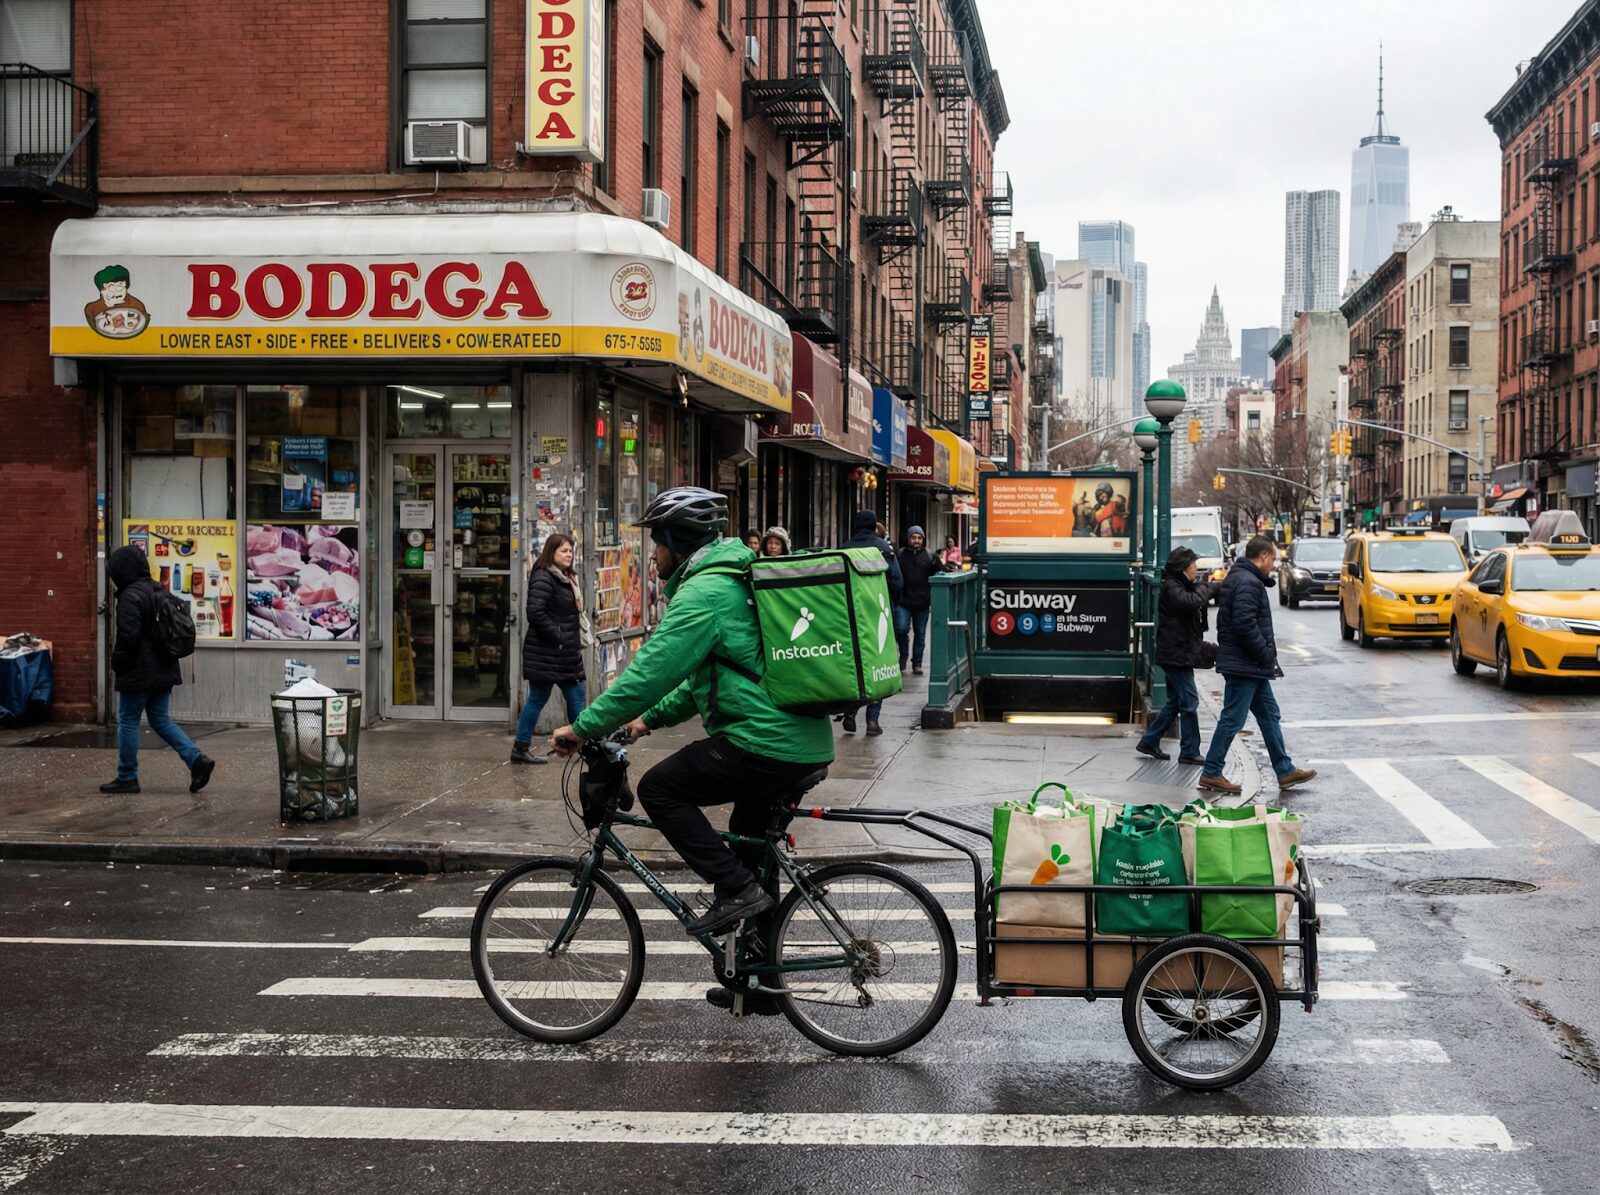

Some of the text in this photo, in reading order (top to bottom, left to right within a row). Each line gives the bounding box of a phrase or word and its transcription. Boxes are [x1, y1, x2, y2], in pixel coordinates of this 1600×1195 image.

[536, 0, 576, 139] DEGA
[187, 260, 551, 320] BODEGA
[160, 333, 210, 349] LOWER
[215, 333, 252, 349] EAST
[266, 333, 297, 349] SIDE
[311, 333, 348, 349] FREE
[709, 296, 768, 375] BODEGA
[989, 589, 1077, 613] Subway
[996, 616, 1008, 630] 3
[1022, 617, 1033, 630] 9
[771, 640, 843, 661] instacart
